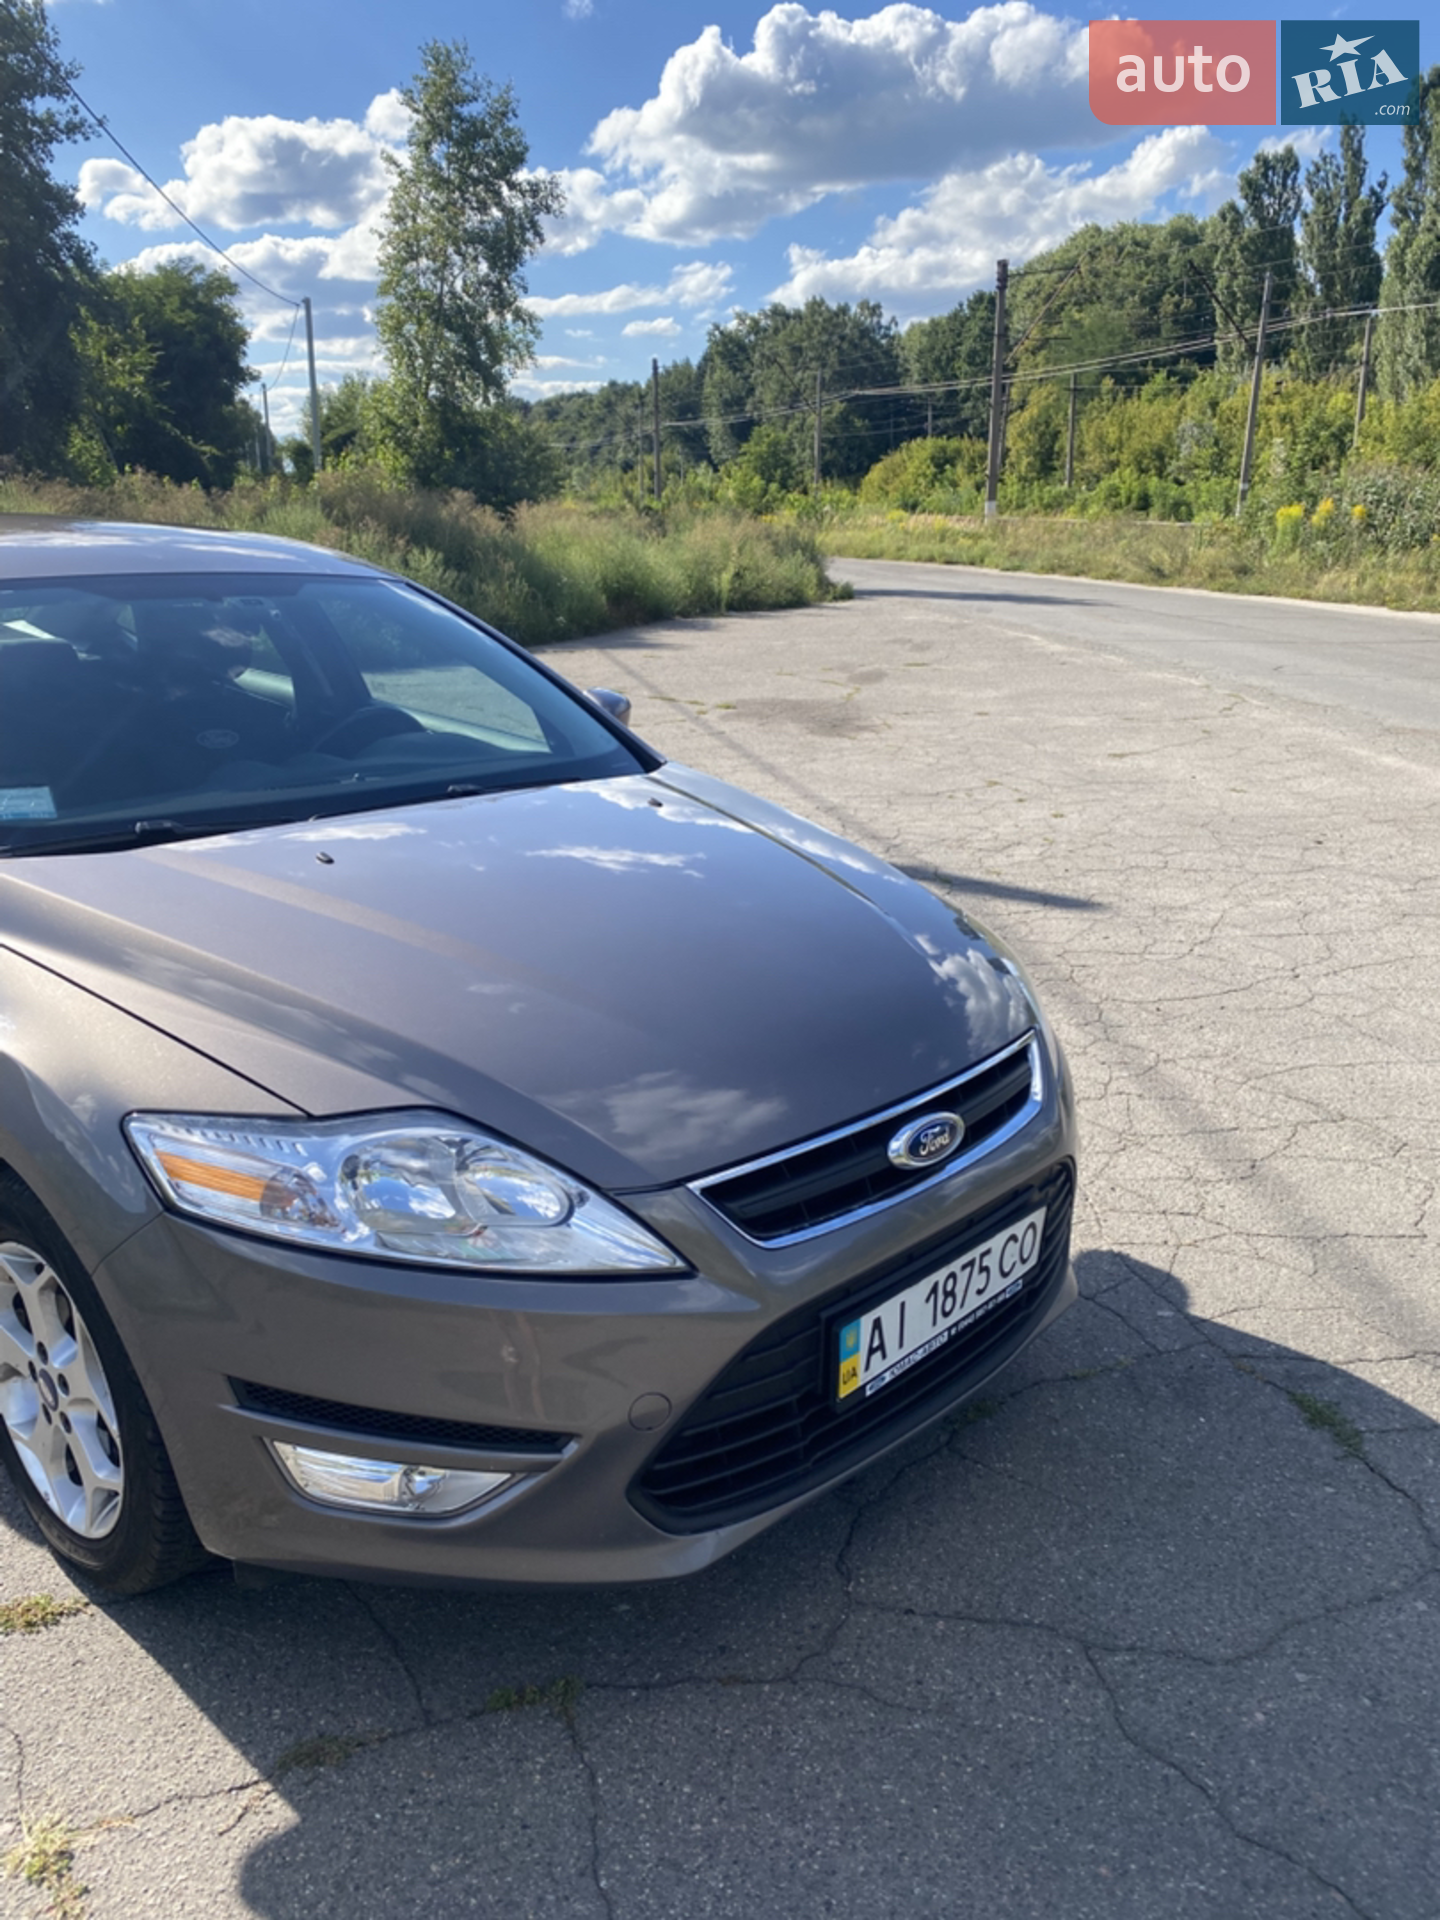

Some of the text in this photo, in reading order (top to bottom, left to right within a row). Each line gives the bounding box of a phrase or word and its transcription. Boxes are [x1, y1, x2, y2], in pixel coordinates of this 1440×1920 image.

[919, 1126, 950, 1156] Ford
[863, 1300, 906, 1373] AI
[924, 1247, 993, 1328] 1875
[998, 1220, 1038, 1279] CO
[842, 1366, 858, 1386] UA
